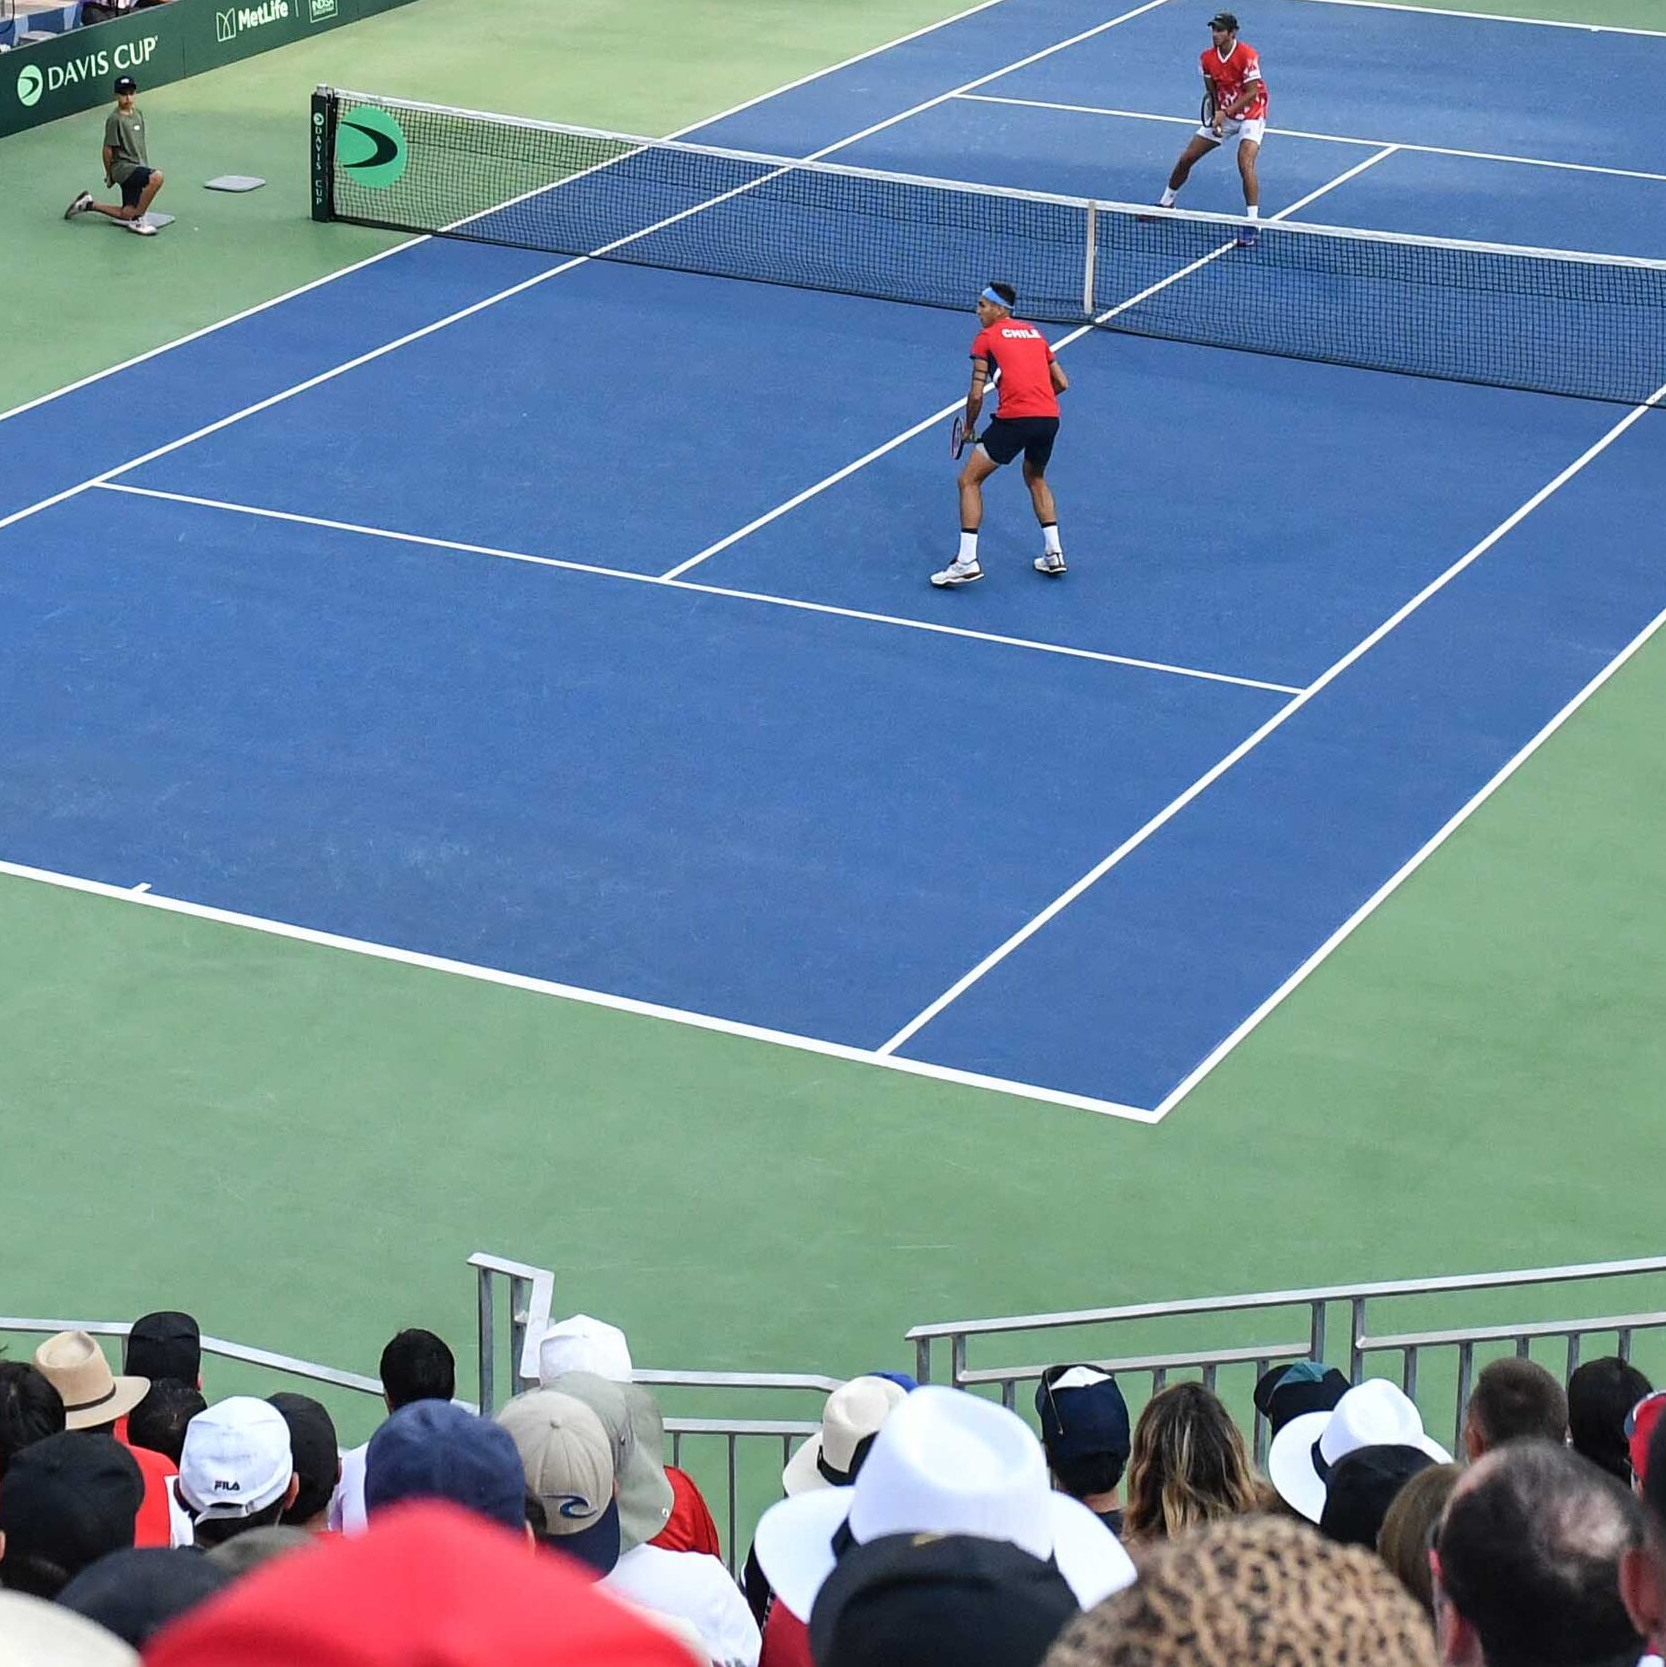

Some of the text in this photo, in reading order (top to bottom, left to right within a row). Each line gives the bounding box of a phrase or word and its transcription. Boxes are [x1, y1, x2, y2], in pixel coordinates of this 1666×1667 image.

[47, 50, 109, 92] DAVIS
[1001, 327, 1042, 339] CHILE
[214, 1480, 240, 1491] FILA
